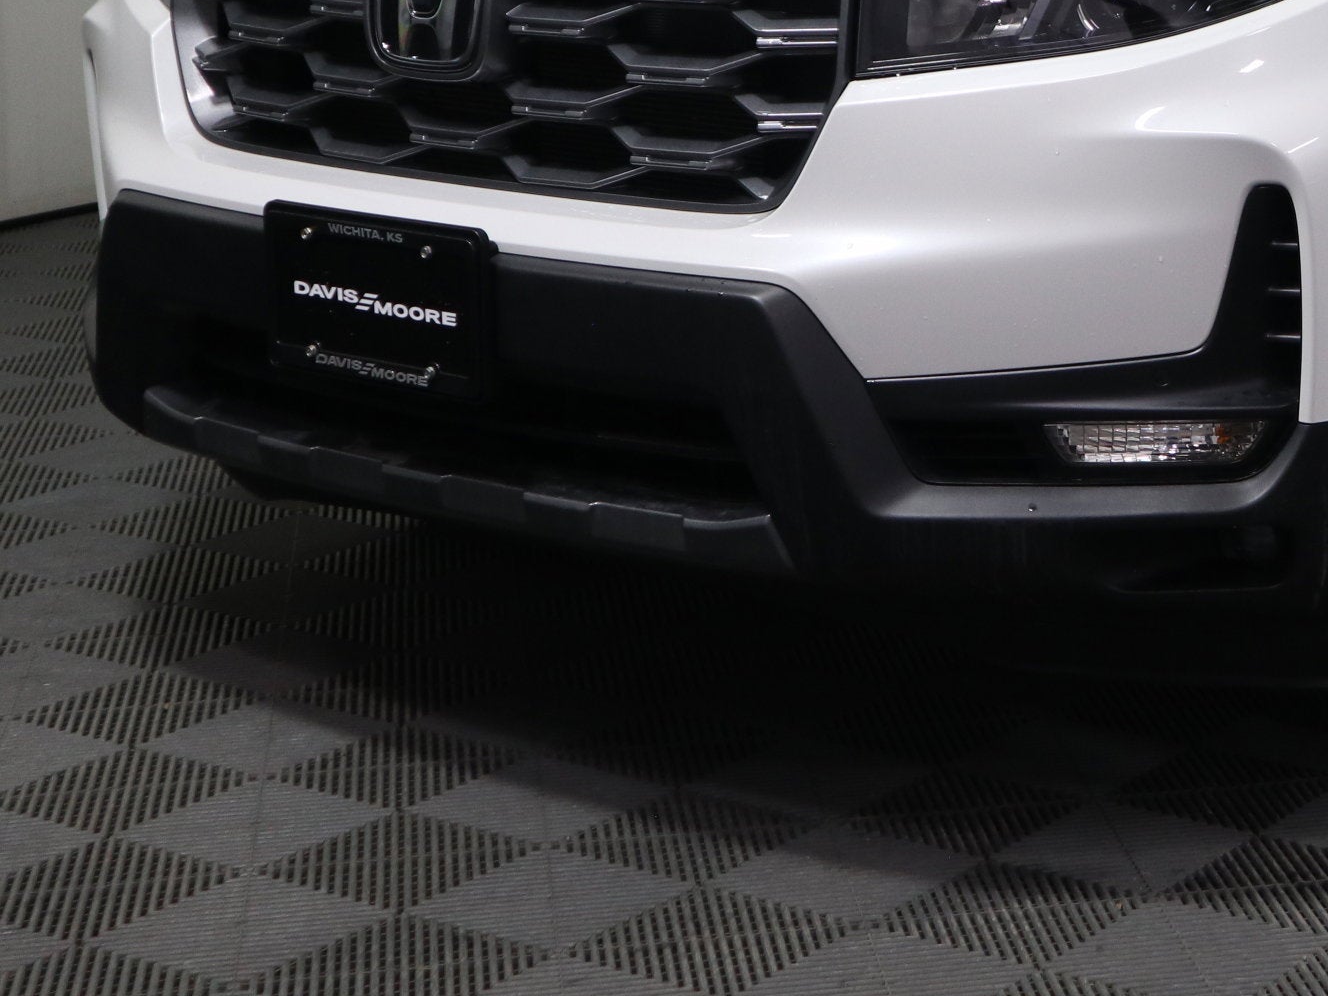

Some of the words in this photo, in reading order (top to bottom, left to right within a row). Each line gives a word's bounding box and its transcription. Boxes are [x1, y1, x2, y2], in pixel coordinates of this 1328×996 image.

[327, 222, 384, 242] WICHITA,
[386, 232, 403, 244] KS
[293, 280, 359, 304] DAVIS
[374, 301, 457, 327] MOORE
[315, 353, 363, 372] DAVIS
[371, 366, 429, 387] MOORE
